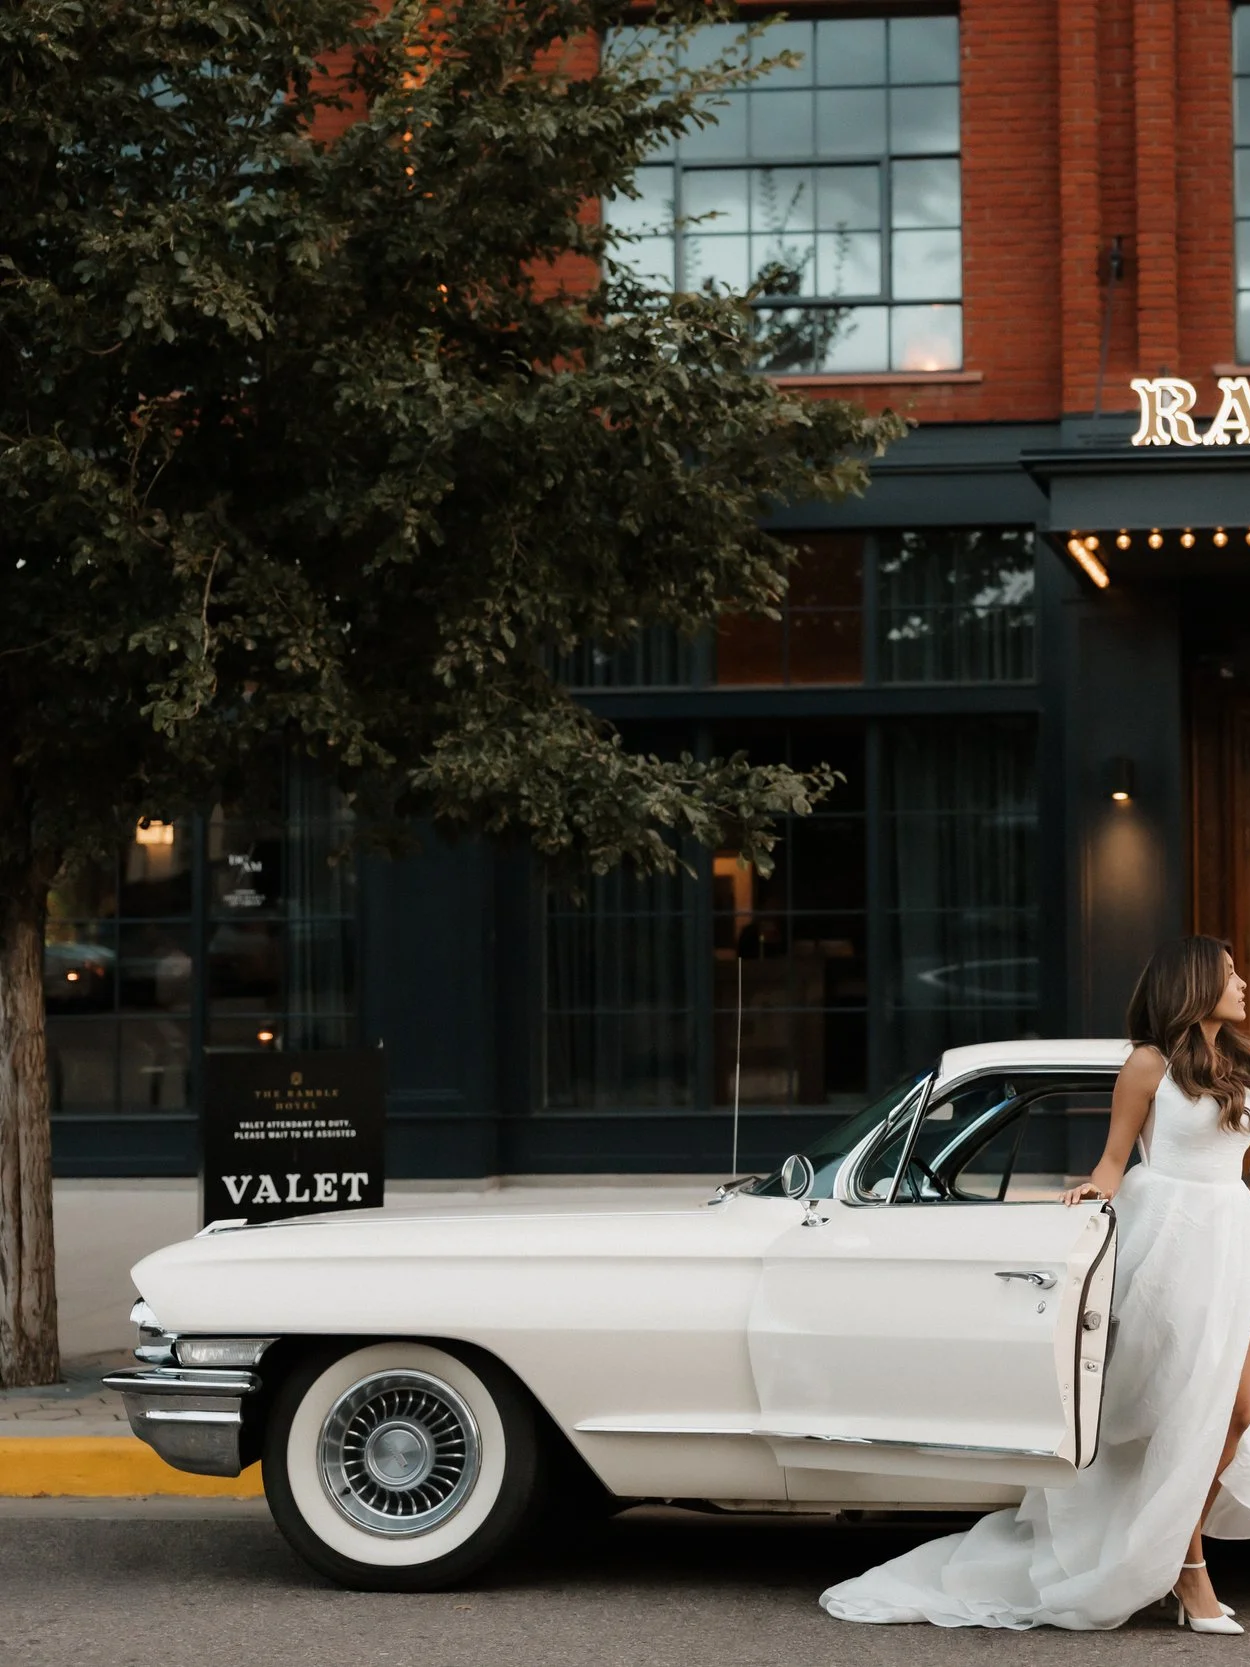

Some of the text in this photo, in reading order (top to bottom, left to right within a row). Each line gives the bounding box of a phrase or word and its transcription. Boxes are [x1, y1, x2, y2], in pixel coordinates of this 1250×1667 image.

[255, 1090, 280, 1098] THE
[275, 1102, 317, 1110] HOTEL
[239, 1121, 264, 1130] VALET
[266, 1120, 312, 1129] ATTENDANT
[314, 1120, 326, 1128] ON
[234, 1129, 357, 1140] PLEASE WAIT TO BE ASSISTED
[221, 1172, 369, 1205] VALET
